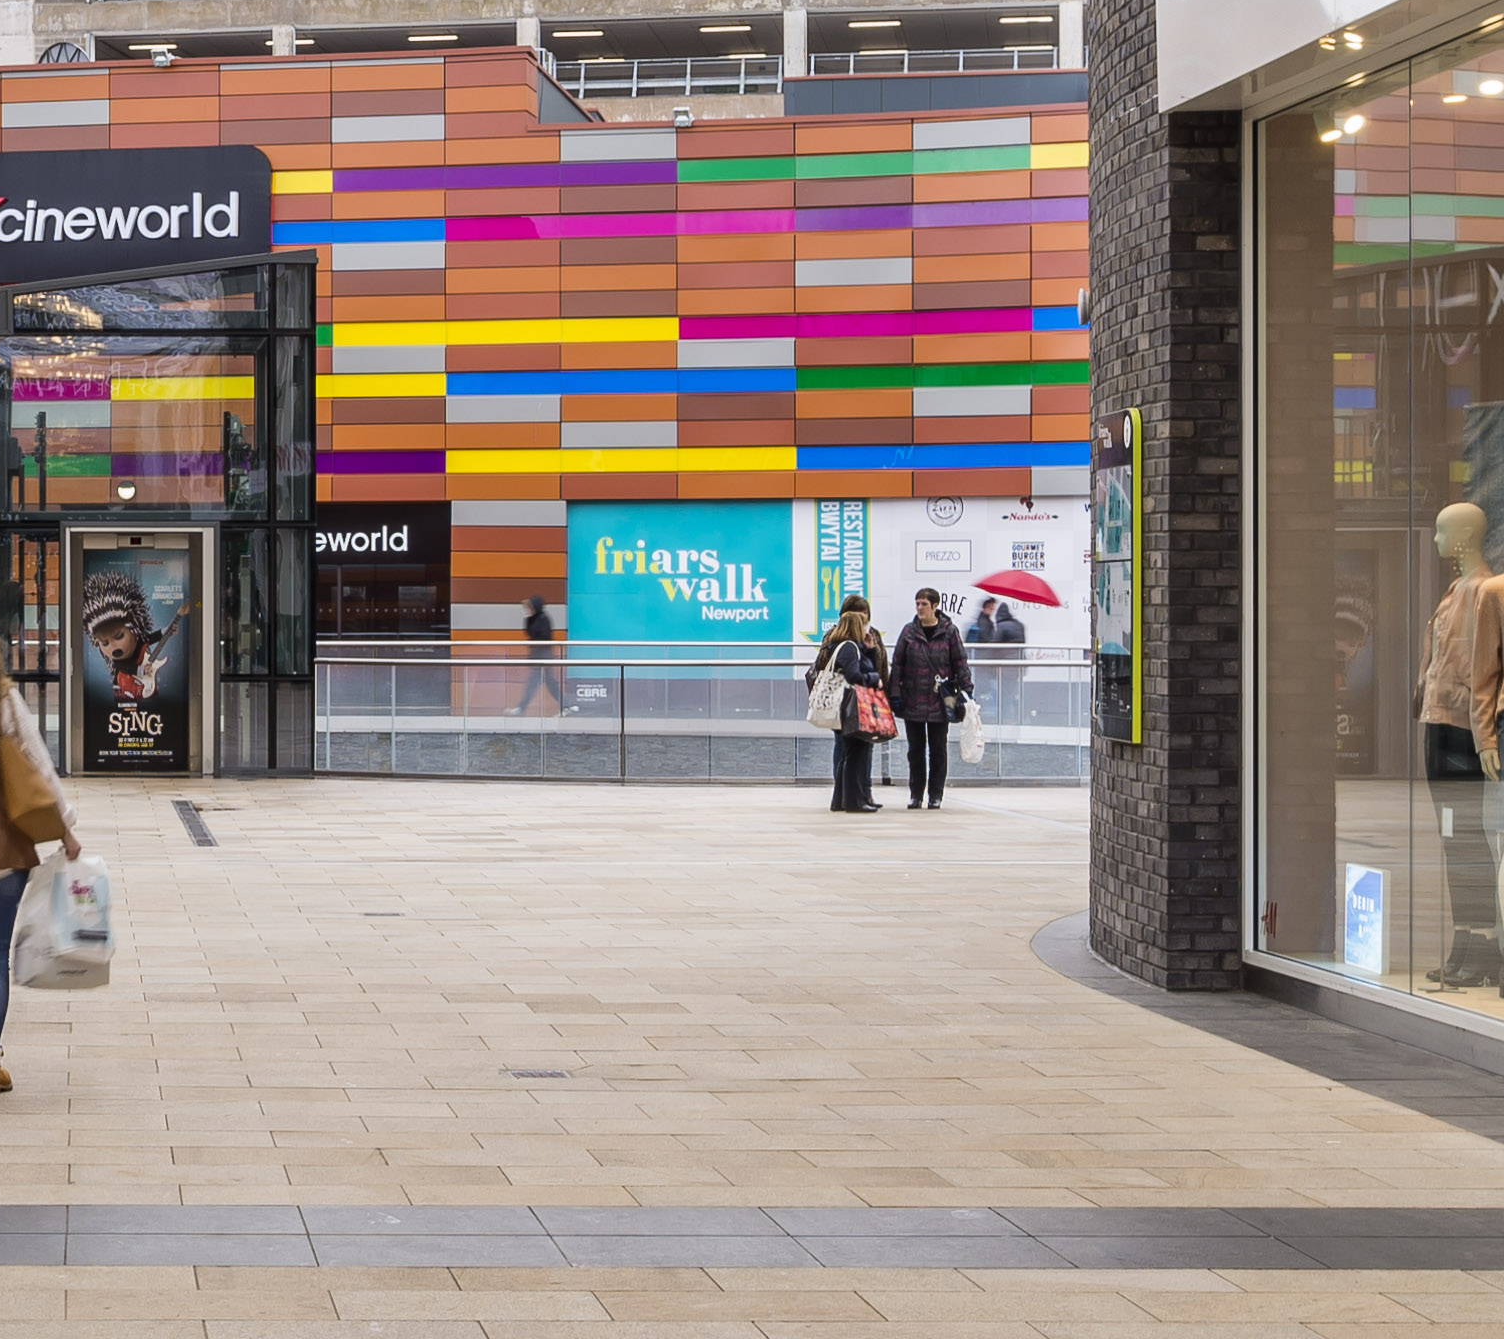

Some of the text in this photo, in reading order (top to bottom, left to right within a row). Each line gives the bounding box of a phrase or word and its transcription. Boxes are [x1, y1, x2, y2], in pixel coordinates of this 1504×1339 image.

[1009, 510, 1052, 522] Nando's
[316, 525, 408, 552] eworld
[820, 501, 840, 561] BWYTAI
[594, 536, 720, 574] friars
[925, 551, 961, 562] PREZZO
[1011, 544, 1045, 552] GOURMET
[1012, 561, 1045, 569] KITCHEN
[658, 564, 768, 602] walk
[701, 605, 769, 623] Newport
[576, 688, 607, 697] CBRE
[108, 711, 164, 736] SING
